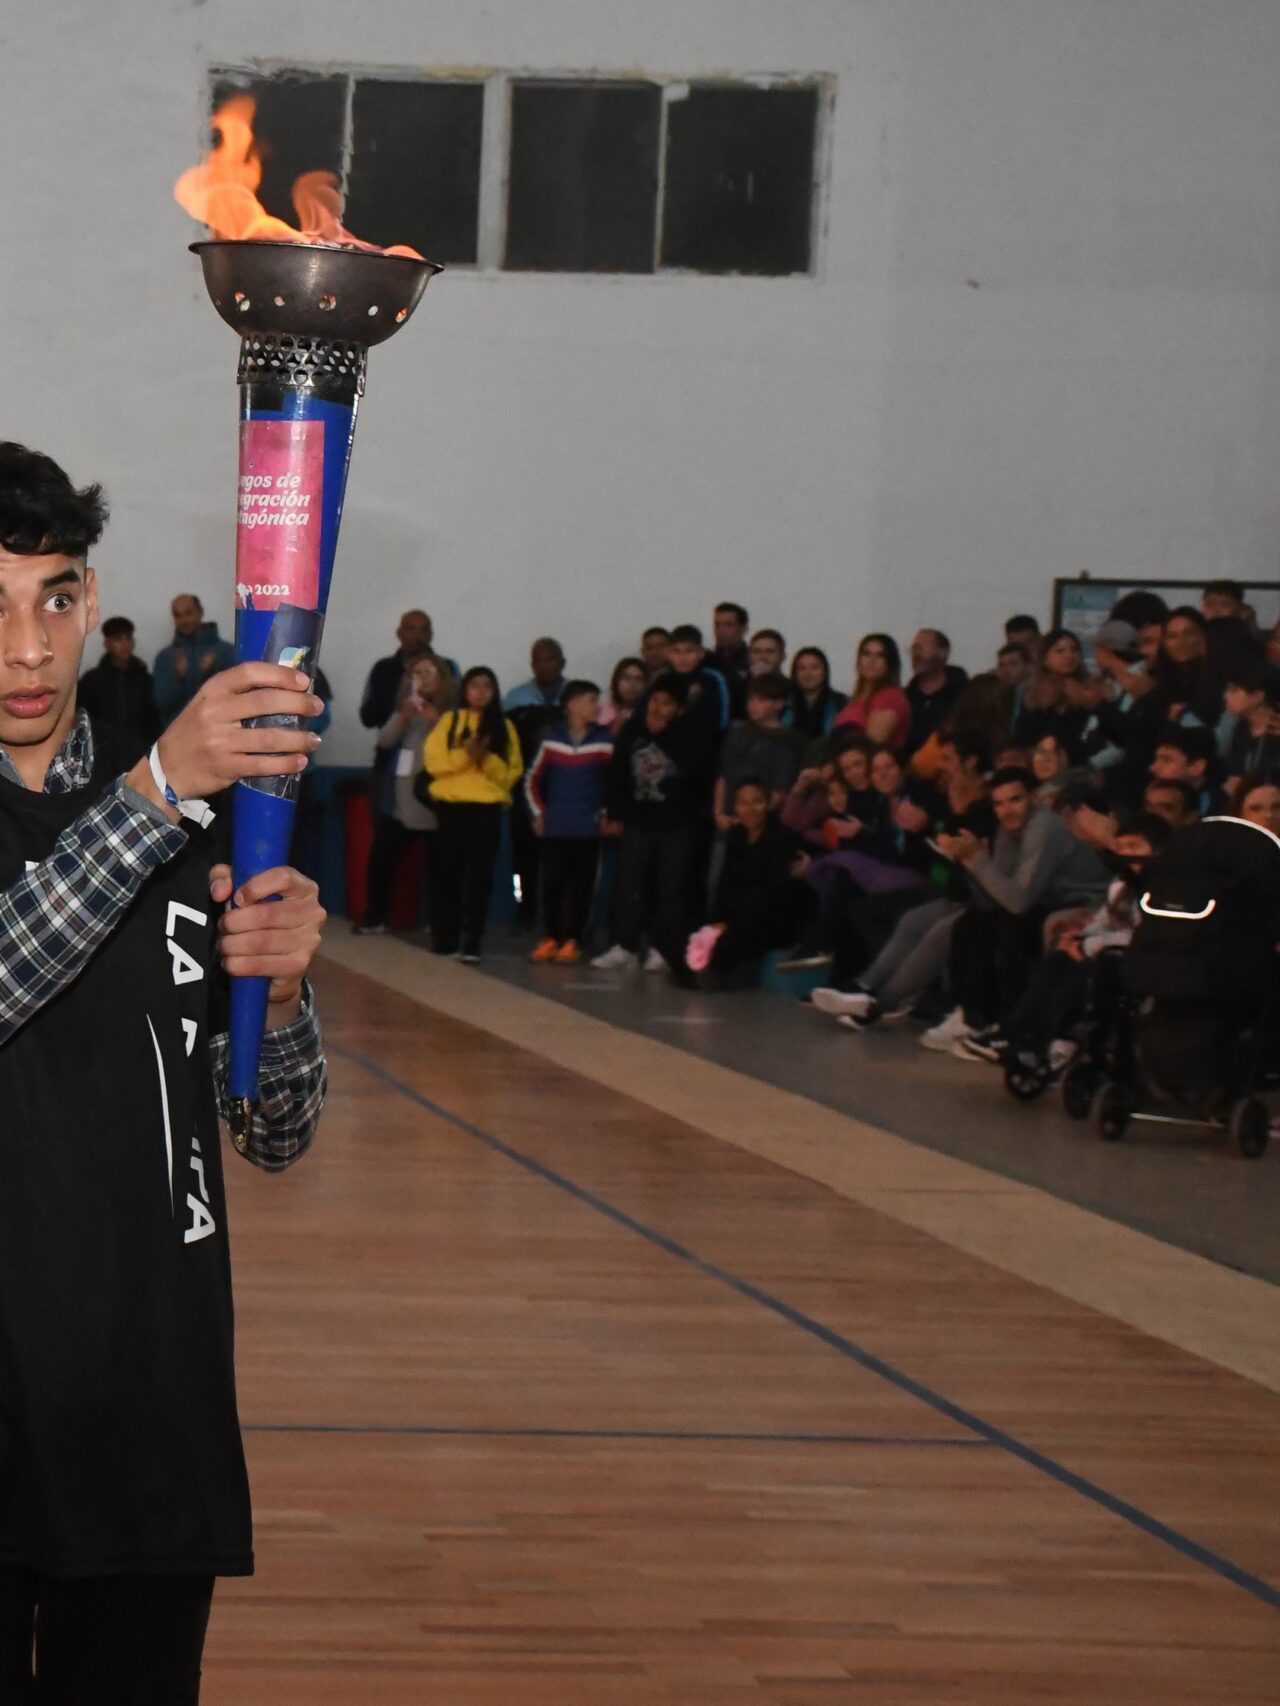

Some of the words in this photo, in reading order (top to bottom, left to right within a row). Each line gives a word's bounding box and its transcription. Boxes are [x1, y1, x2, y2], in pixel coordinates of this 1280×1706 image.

[276, 471, 301, 488] de
[254, 584, 291, 596] 2022
[165, 900, 208, 986] LA
